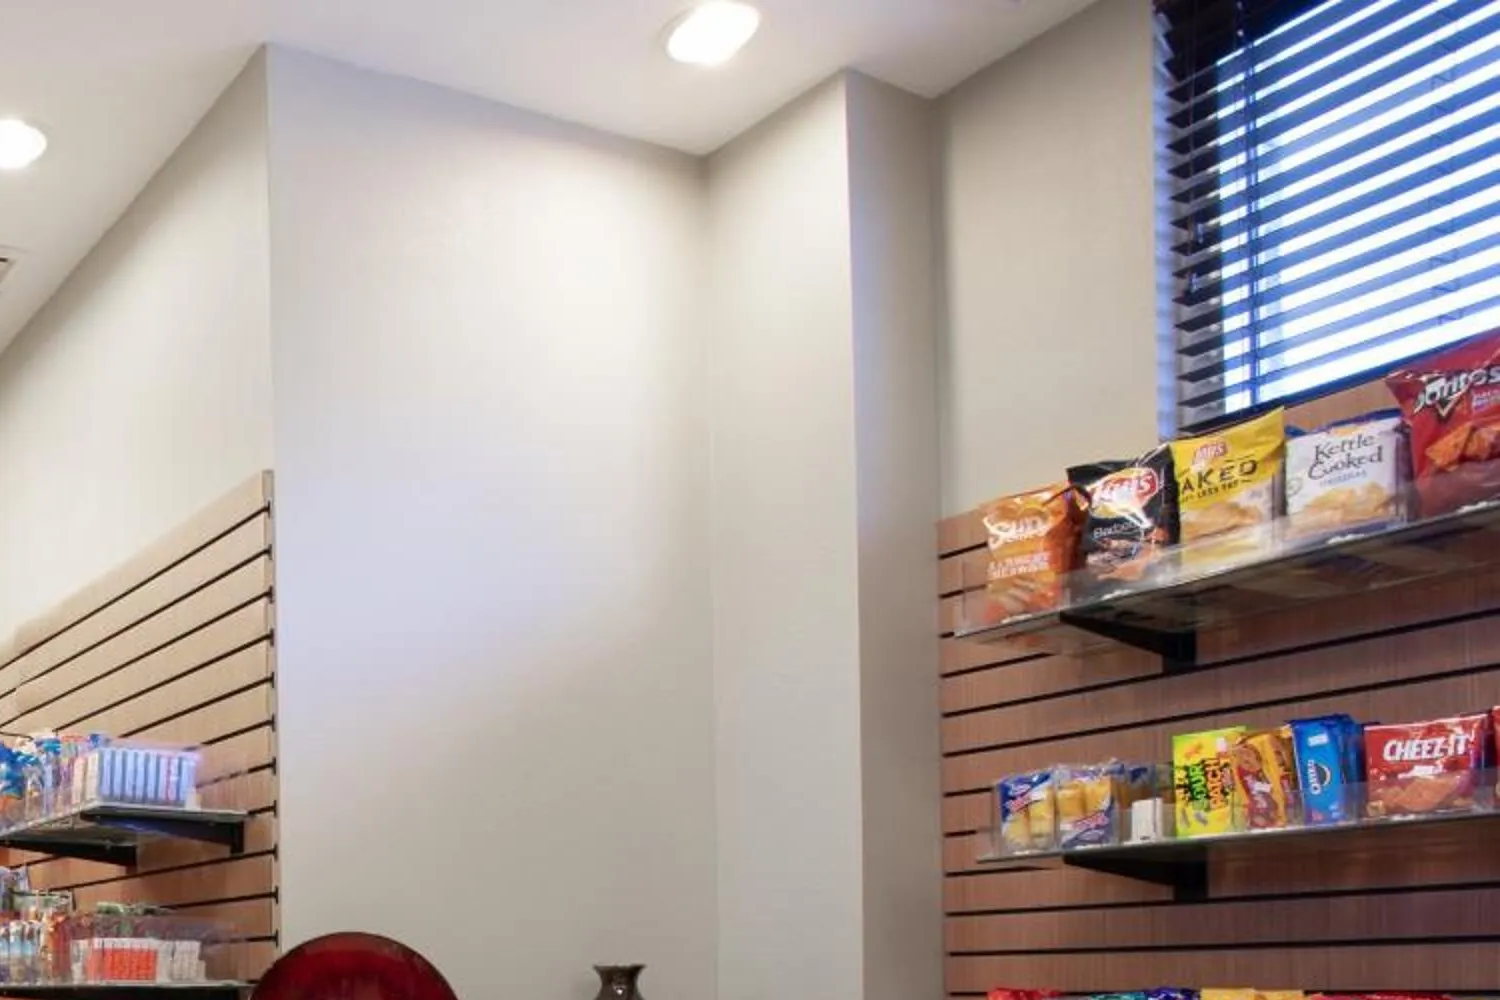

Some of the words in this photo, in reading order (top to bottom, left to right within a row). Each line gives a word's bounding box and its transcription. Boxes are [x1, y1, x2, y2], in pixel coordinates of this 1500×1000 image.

[1314, 433, 1375, 464] Kettle
[1181, 459, 1258, 495] AKED
[1382, 732, 1469, 764] CHEEZ-IT
